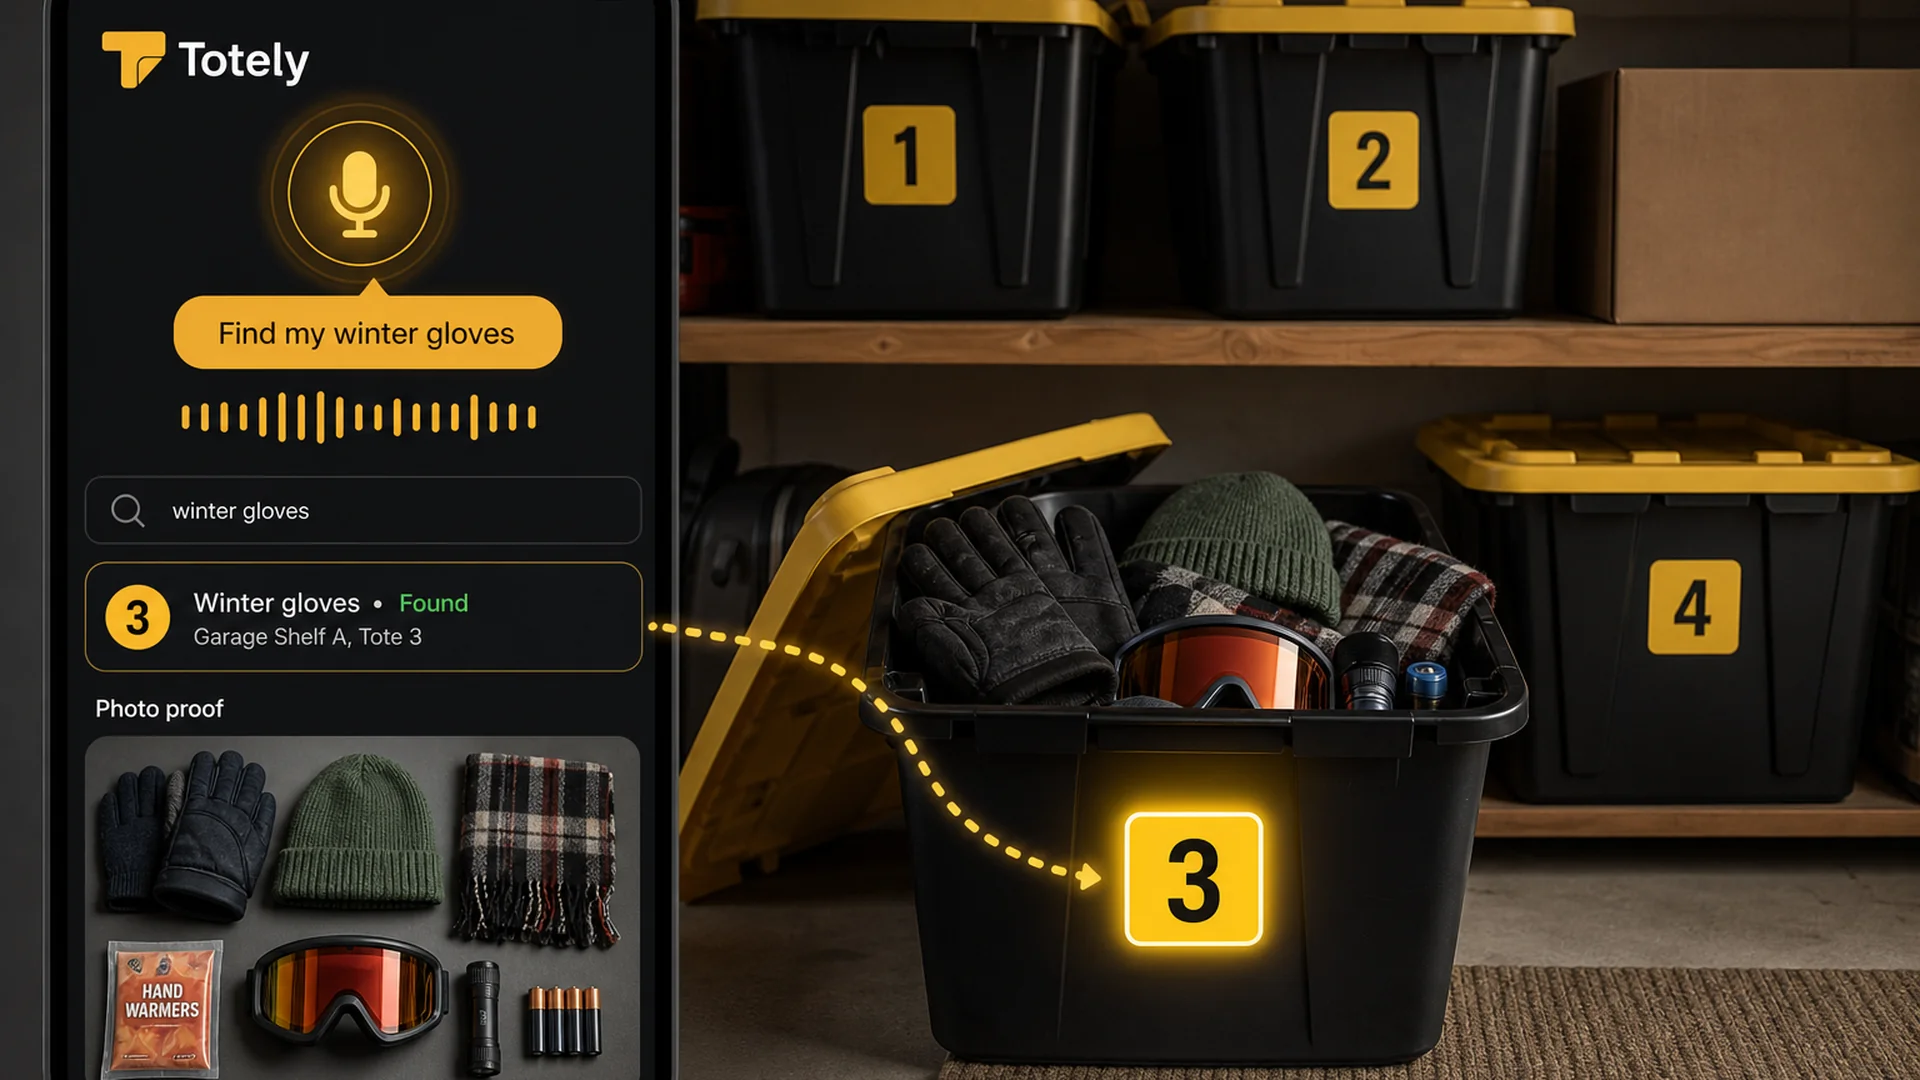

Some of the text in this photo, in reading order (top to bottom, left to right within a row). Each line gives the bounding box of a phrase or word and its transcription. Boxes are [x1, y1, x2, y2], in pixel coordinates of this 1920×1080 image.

[178, 42, 309, 86] Totely
[894, 126, 917, 187] 1
[1356, 131, 1391, 190] 2
[219, 321, 515, 351] Find my winter gloves
[172, 502, 309, 525] winter gloves
[126, 600, 149, 635] 3
[193, 592, 469, 619] Winter gloves Found
[1674, 579, 1712, 636] 4
[193, 627, 422, 650] Garage Shelf A, Tote 3
[96, 699, 225, 723] Photo proof
[1168, 839, 1221, 923] 3
[142, 983, 183, 999] HAND
[125, 1002, 199, 1018] WARMERS
